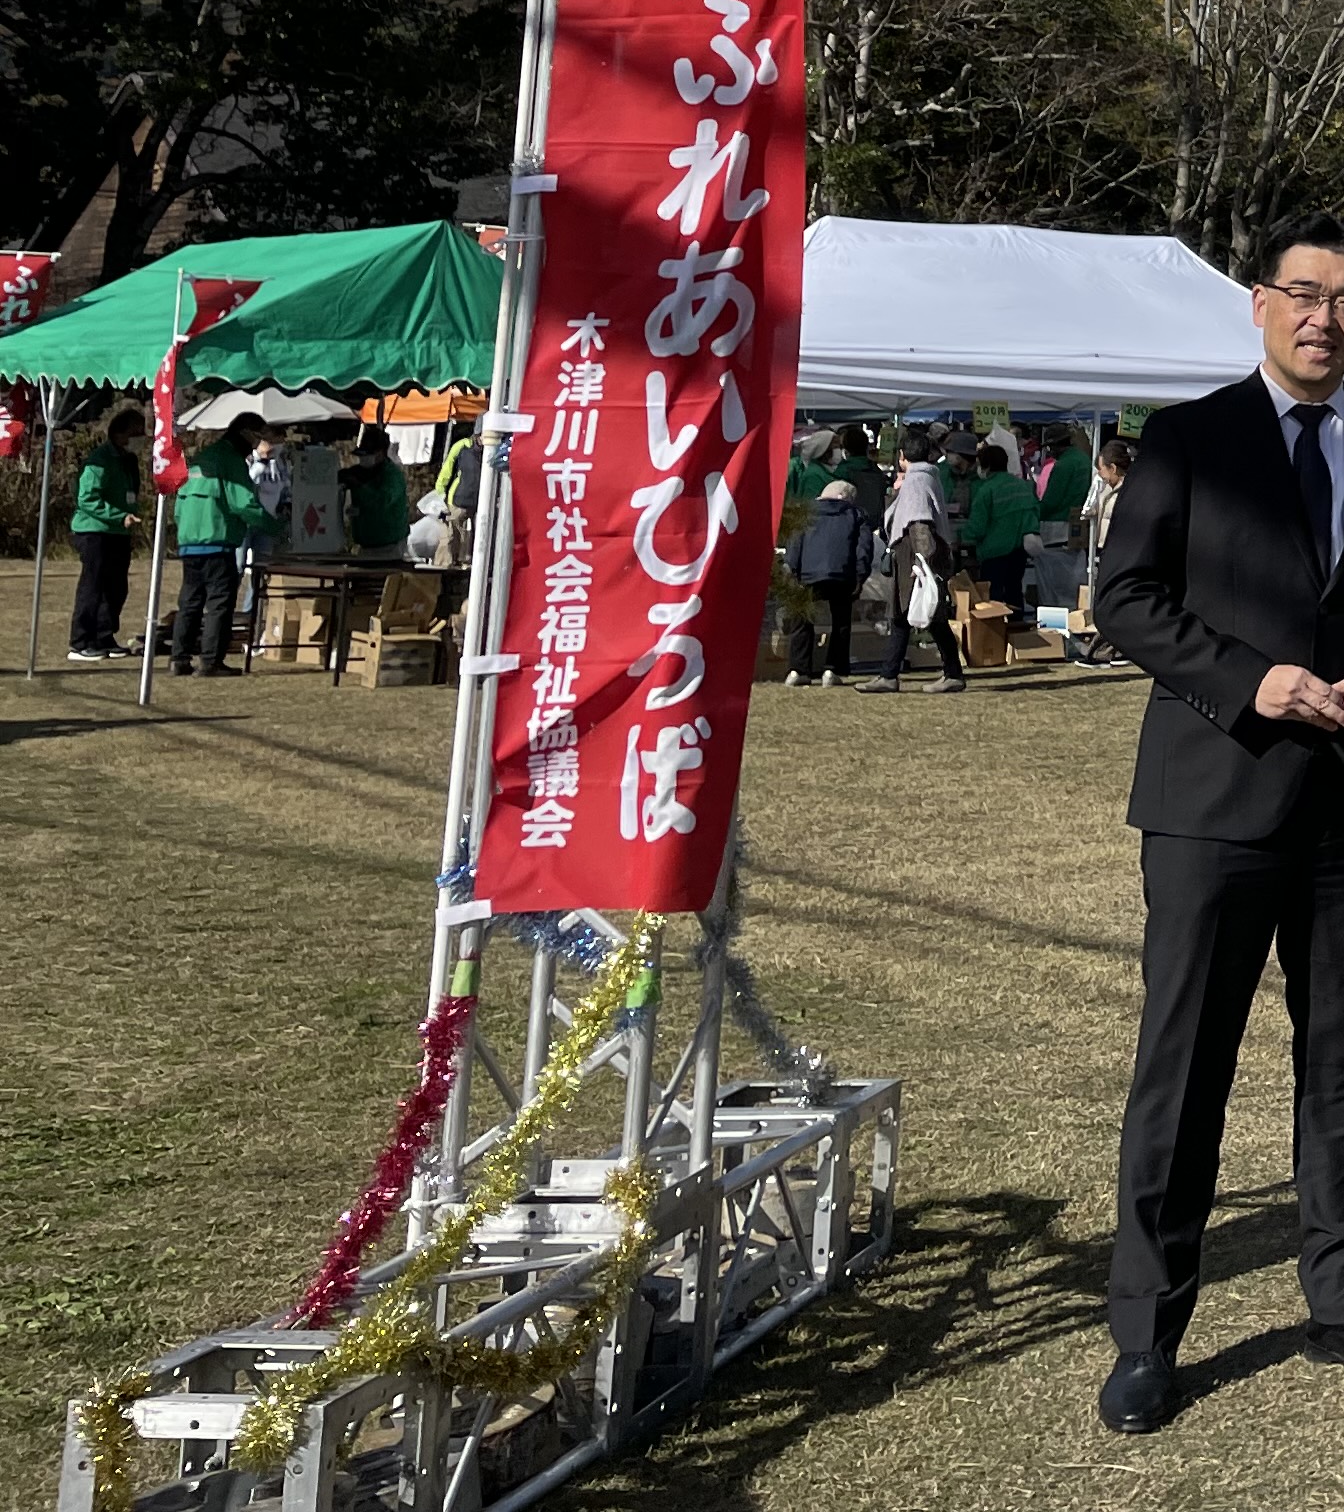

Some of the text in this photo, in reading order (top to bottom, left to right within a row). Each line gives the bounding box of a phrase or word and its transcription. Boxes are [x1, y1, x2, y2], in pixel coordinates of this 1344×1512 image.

[519, 311, 611, 850] 木津川市社会福祉協議会
